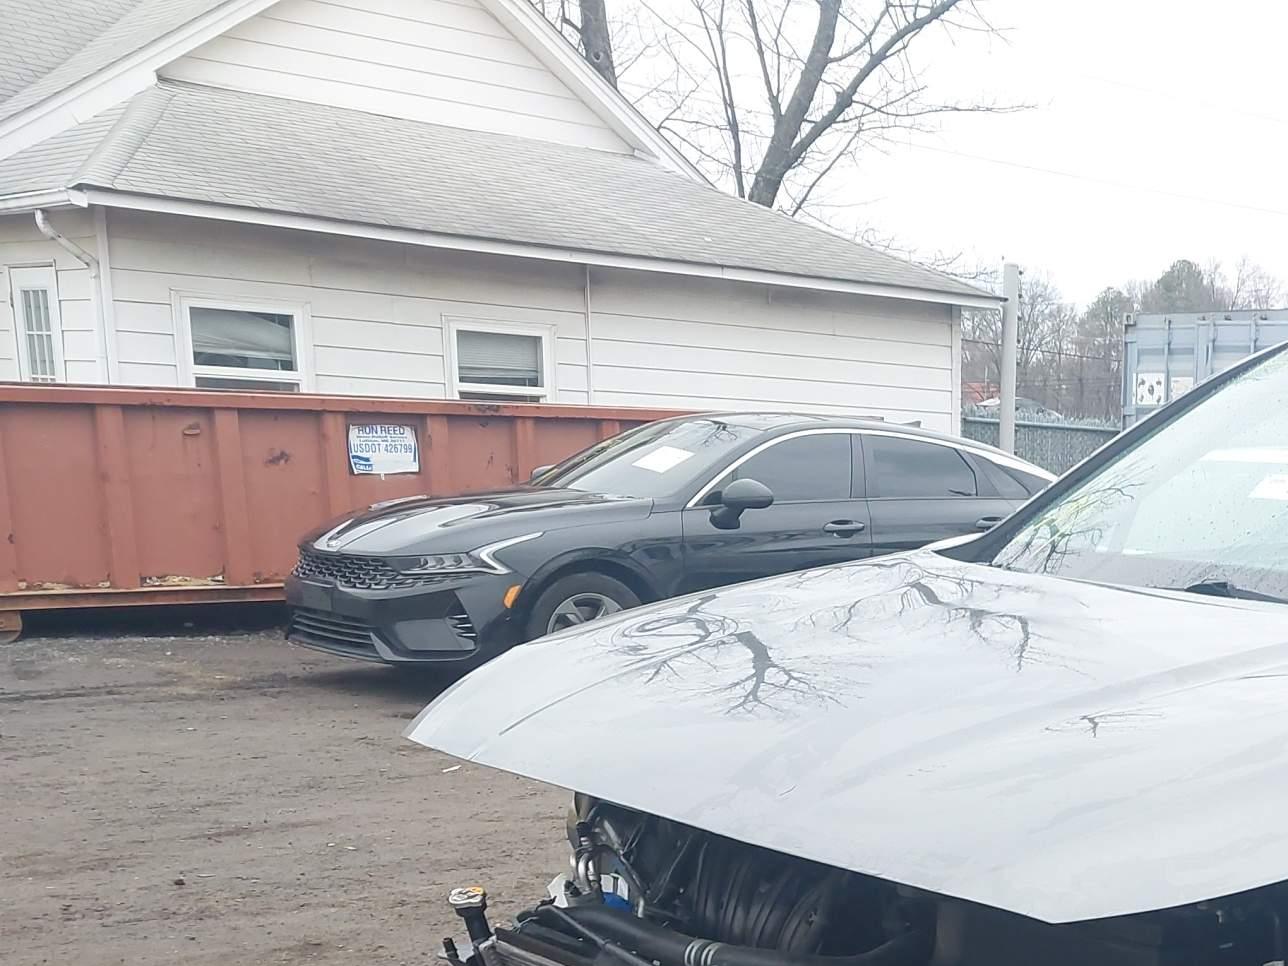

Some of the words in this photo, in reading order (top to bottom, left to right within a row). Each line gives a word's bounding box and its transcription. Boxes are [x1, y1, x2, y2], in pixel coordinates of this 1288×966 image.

[380, 425, 405, 435] REED
[353, 443, 382, 453] USDOT
[384, 443, 413, 453] 426799
